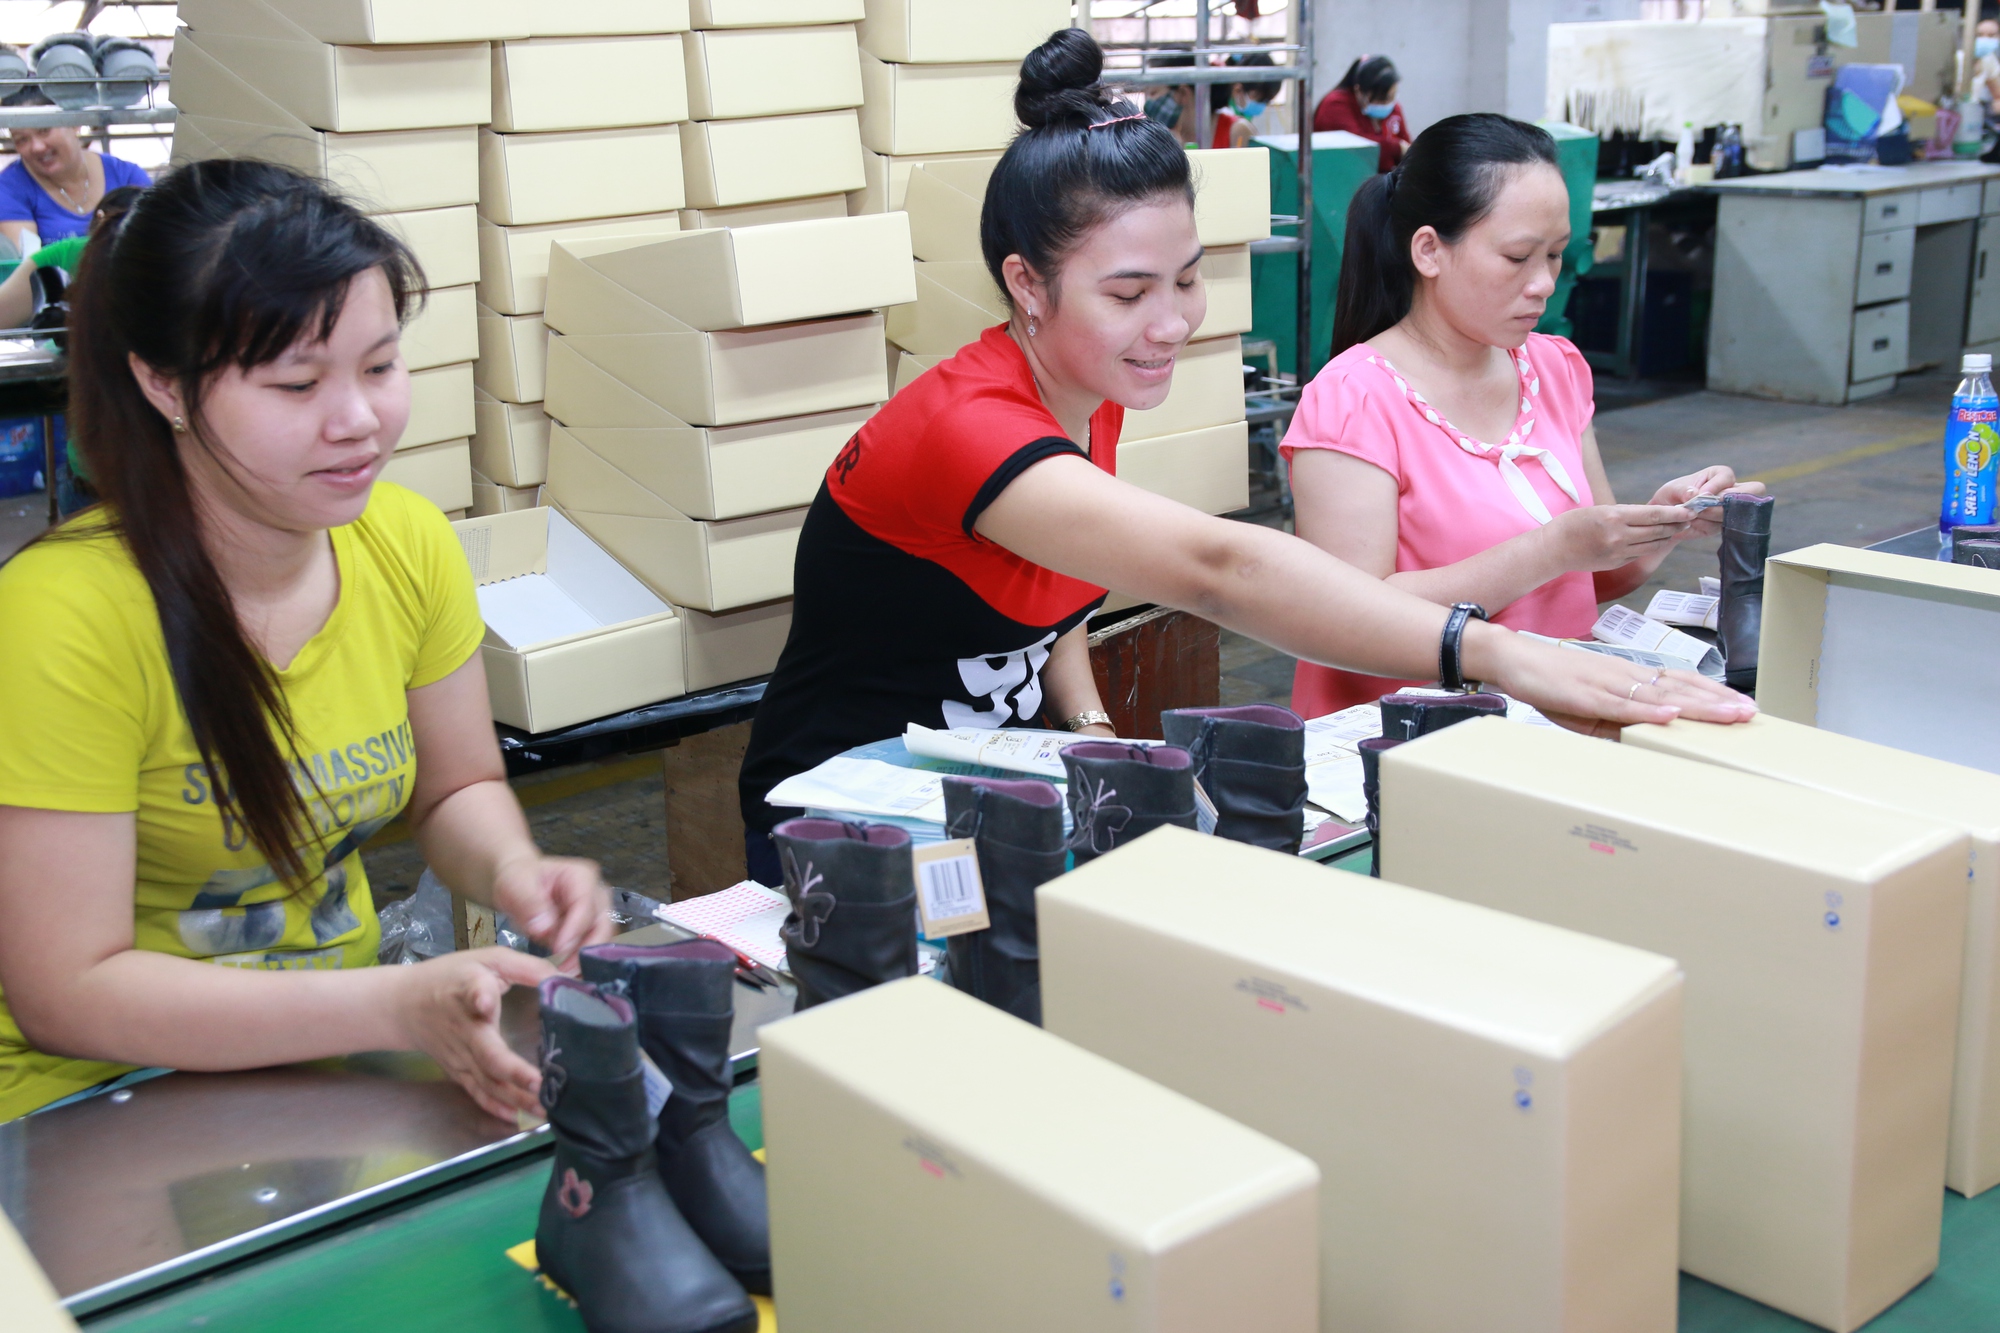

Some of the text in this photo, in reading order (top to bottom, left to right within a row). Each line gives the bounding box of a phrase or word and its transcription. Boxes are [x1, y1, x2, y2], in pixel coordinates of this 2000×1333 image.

[1957, 408, 1998, 422] RESTORE
[1964, 430, 1982, 517] SALTY LEMON
